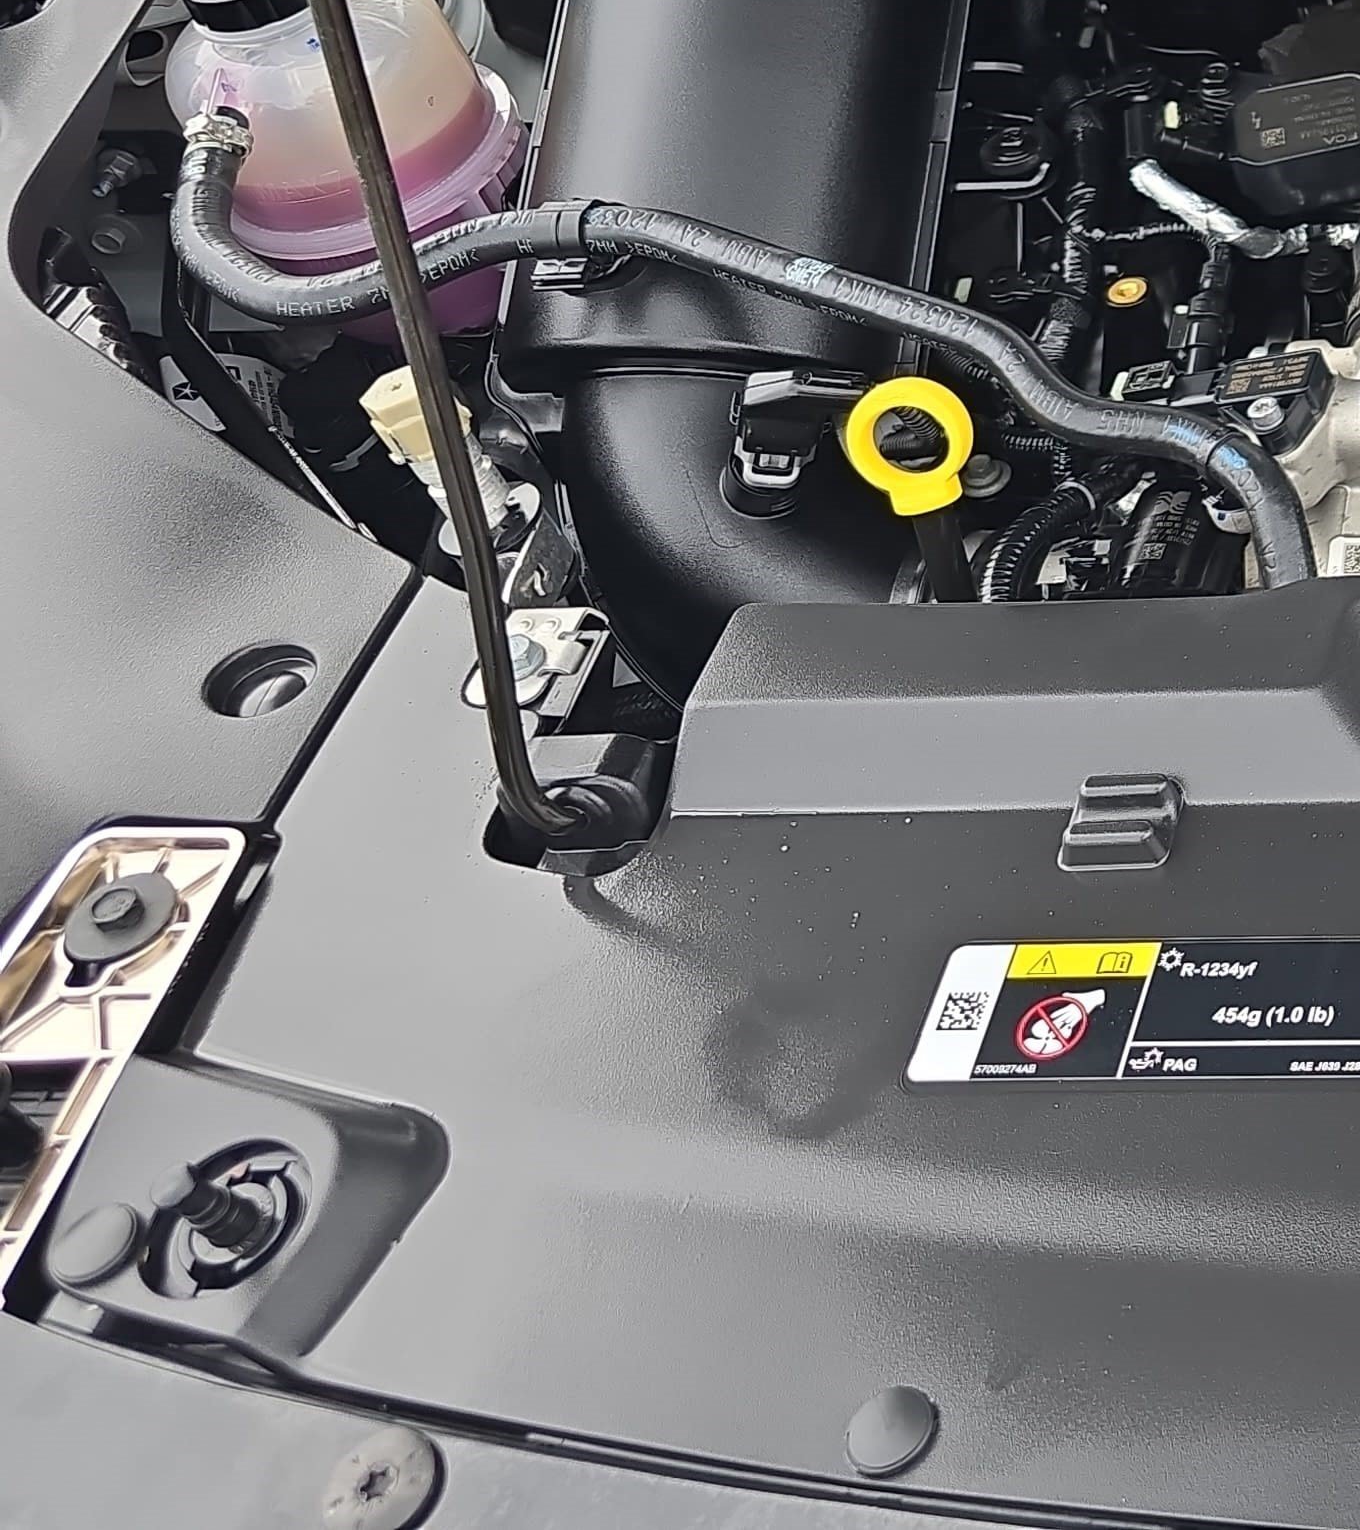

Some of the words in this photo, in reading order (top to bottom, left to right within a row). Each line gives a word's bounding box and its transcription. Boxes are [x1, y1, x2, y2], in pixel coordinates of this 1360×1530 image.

[711, 267, 767, 295] HEATER
[275, 296, 355, 318] HEATER
[898, 296, 979, 339] 120324
[1000, 341, 1026, 373] 2A
[1180, 962, 1258, 979] R-1234yf
[1212, 1007, 1261, 1027] 454g
[1266, 1007, 1301, 1027] (1.0
[1307, 1006, 1335, 1027] lb)
[1163, 1059, 1197, 1071] PAG
[1290, 1061, 1314, 1071] SAE
[1315, 1061, 1341, 1071] J639
